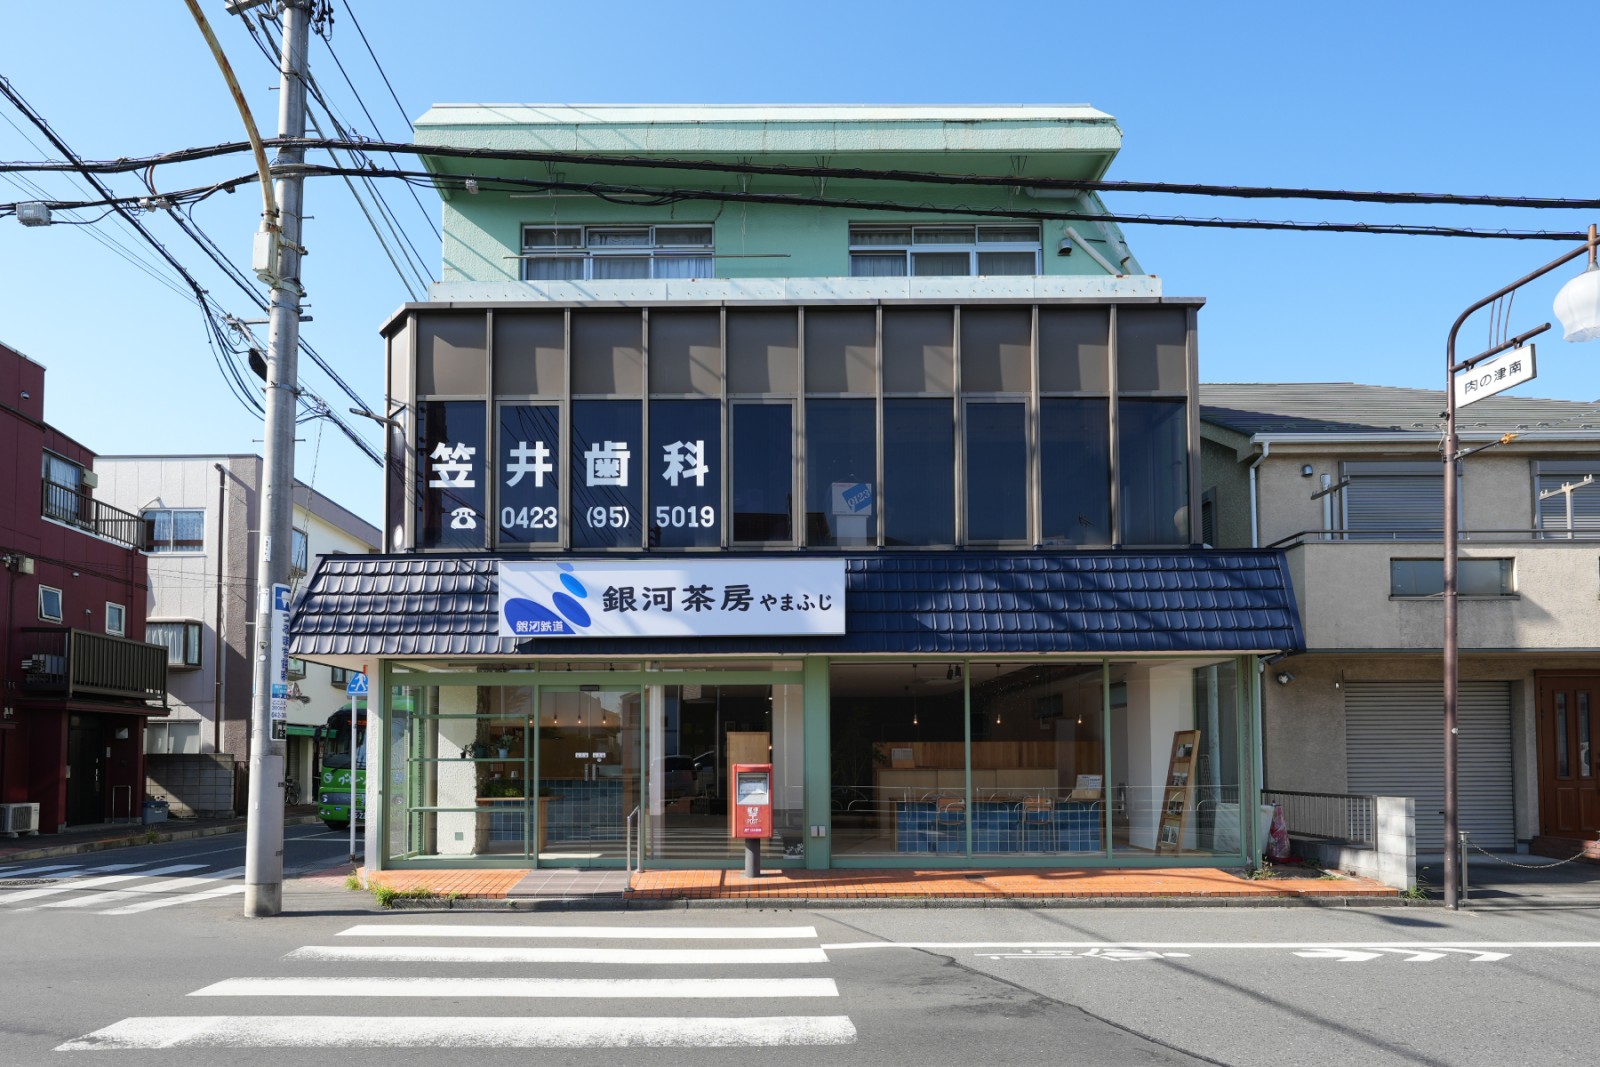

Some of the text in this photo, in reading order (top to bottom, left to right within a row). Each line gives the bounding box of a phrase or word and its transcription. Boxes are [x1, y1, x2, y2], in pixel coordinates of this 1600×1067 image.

[1464, 360, 1522, 395] 肉の津南
[428, 440, 710, 488] 笠井歯科
[847, 489, 871, 507] 0123
[501, 505, 716, 528] 0423 (95) 5019
[602, 584, 832, 613] 銀河茶房 やまふじ
[515, 620, 565, 633] 銀河鉄道
